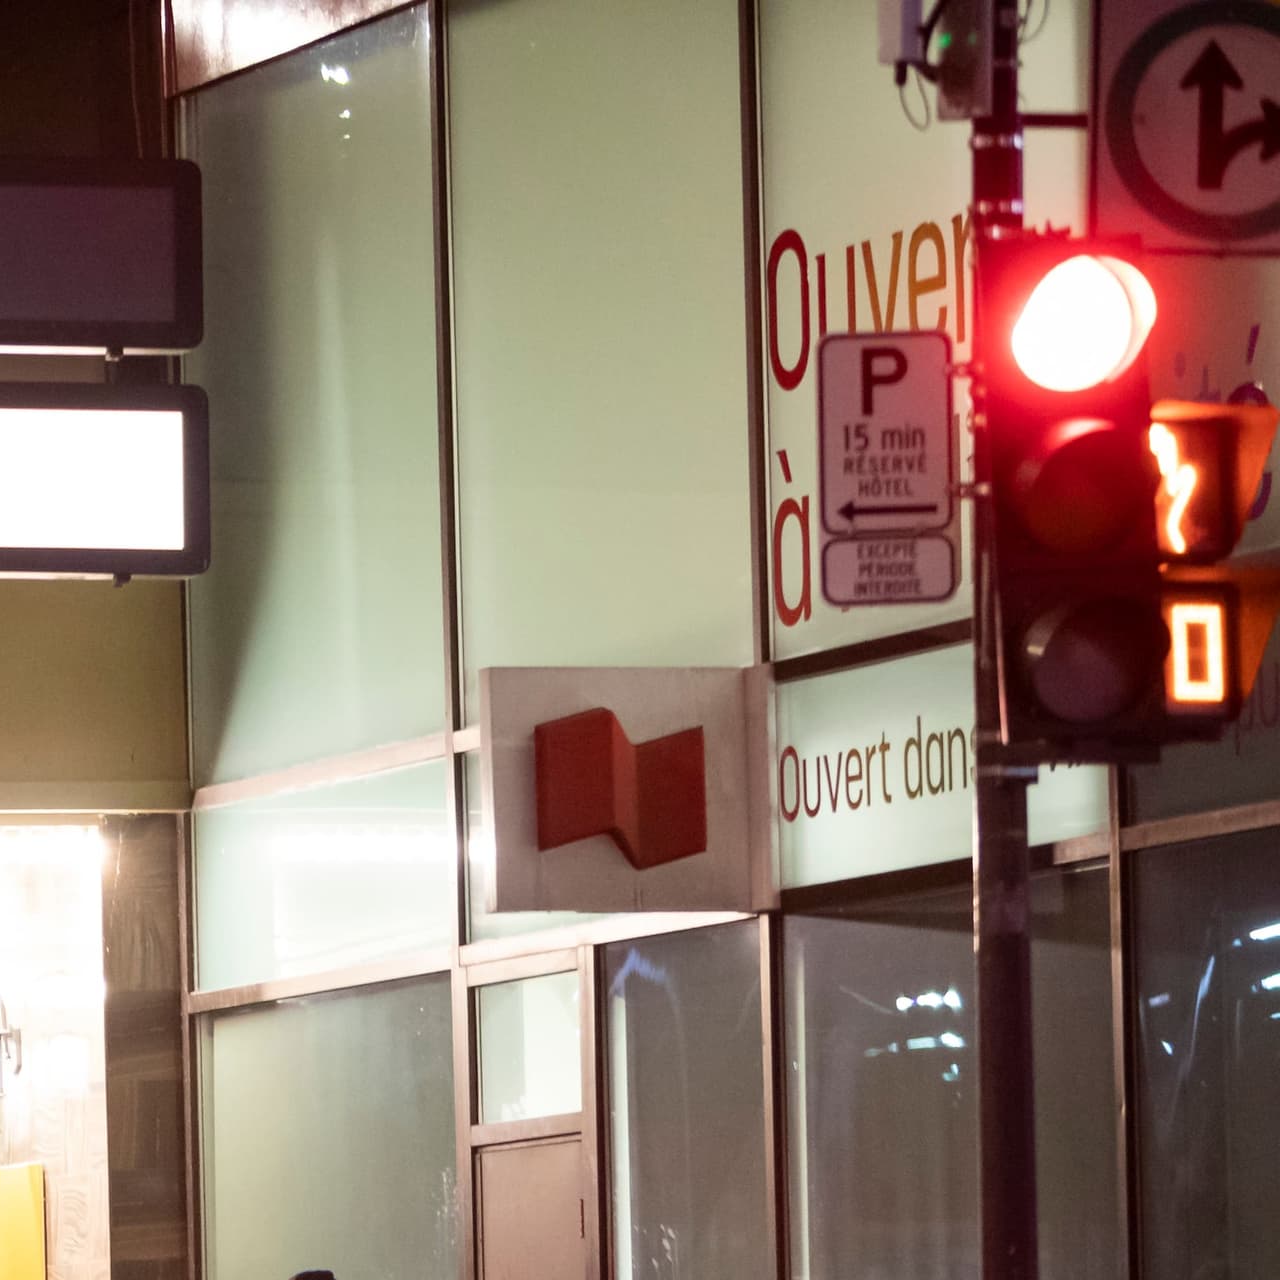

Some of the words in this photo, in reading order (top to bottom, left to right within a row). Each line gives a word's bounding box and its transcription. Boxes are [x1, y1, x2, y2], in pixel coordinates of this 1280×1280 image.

[767, 212, 973, 390] Ouver
[860, 347, 908, 416] P
[843, 424, 870, 452] 15
[880, 426, 926, 450] min
[843, 450, 927, 475] RÉSERVÉ
[857, 474, 913, 497] HÔTEL
[773, 449, 811, 627] à
[778, 731, 892, 823] Ouvert
[903, 715, 975, 803] dan
